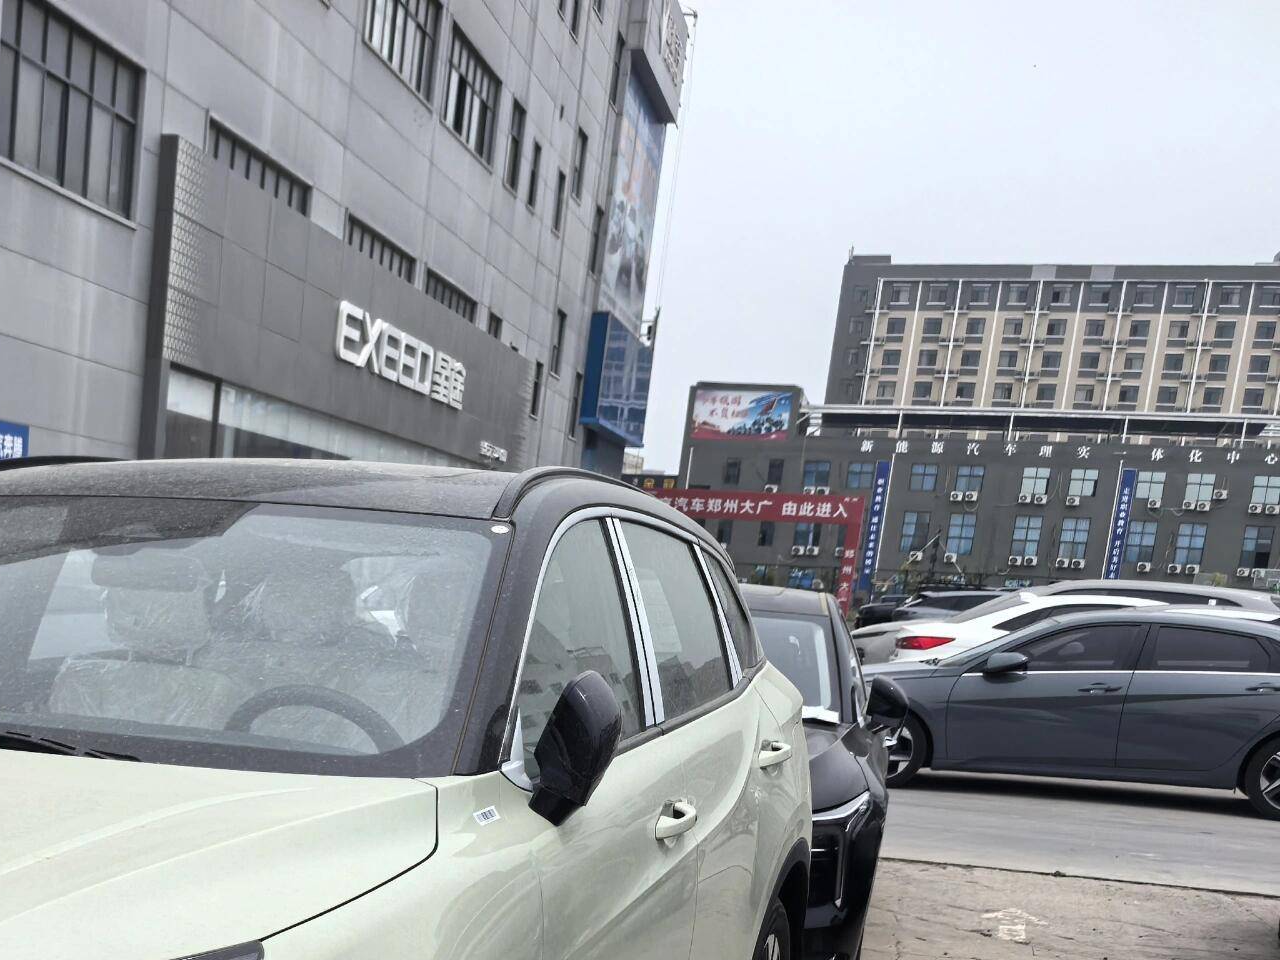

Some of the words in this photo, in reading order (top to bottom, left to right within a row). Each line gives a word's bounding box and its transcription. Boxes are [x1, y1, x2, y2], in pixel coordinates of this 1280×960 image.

[336, 300, 434, 396] EXEED
[431, 351, 466, 410] 星途
[861, 439, 1278, 465] 新能源汽车理实一体化中心
[782, 501, 848, 518] 由此进入
